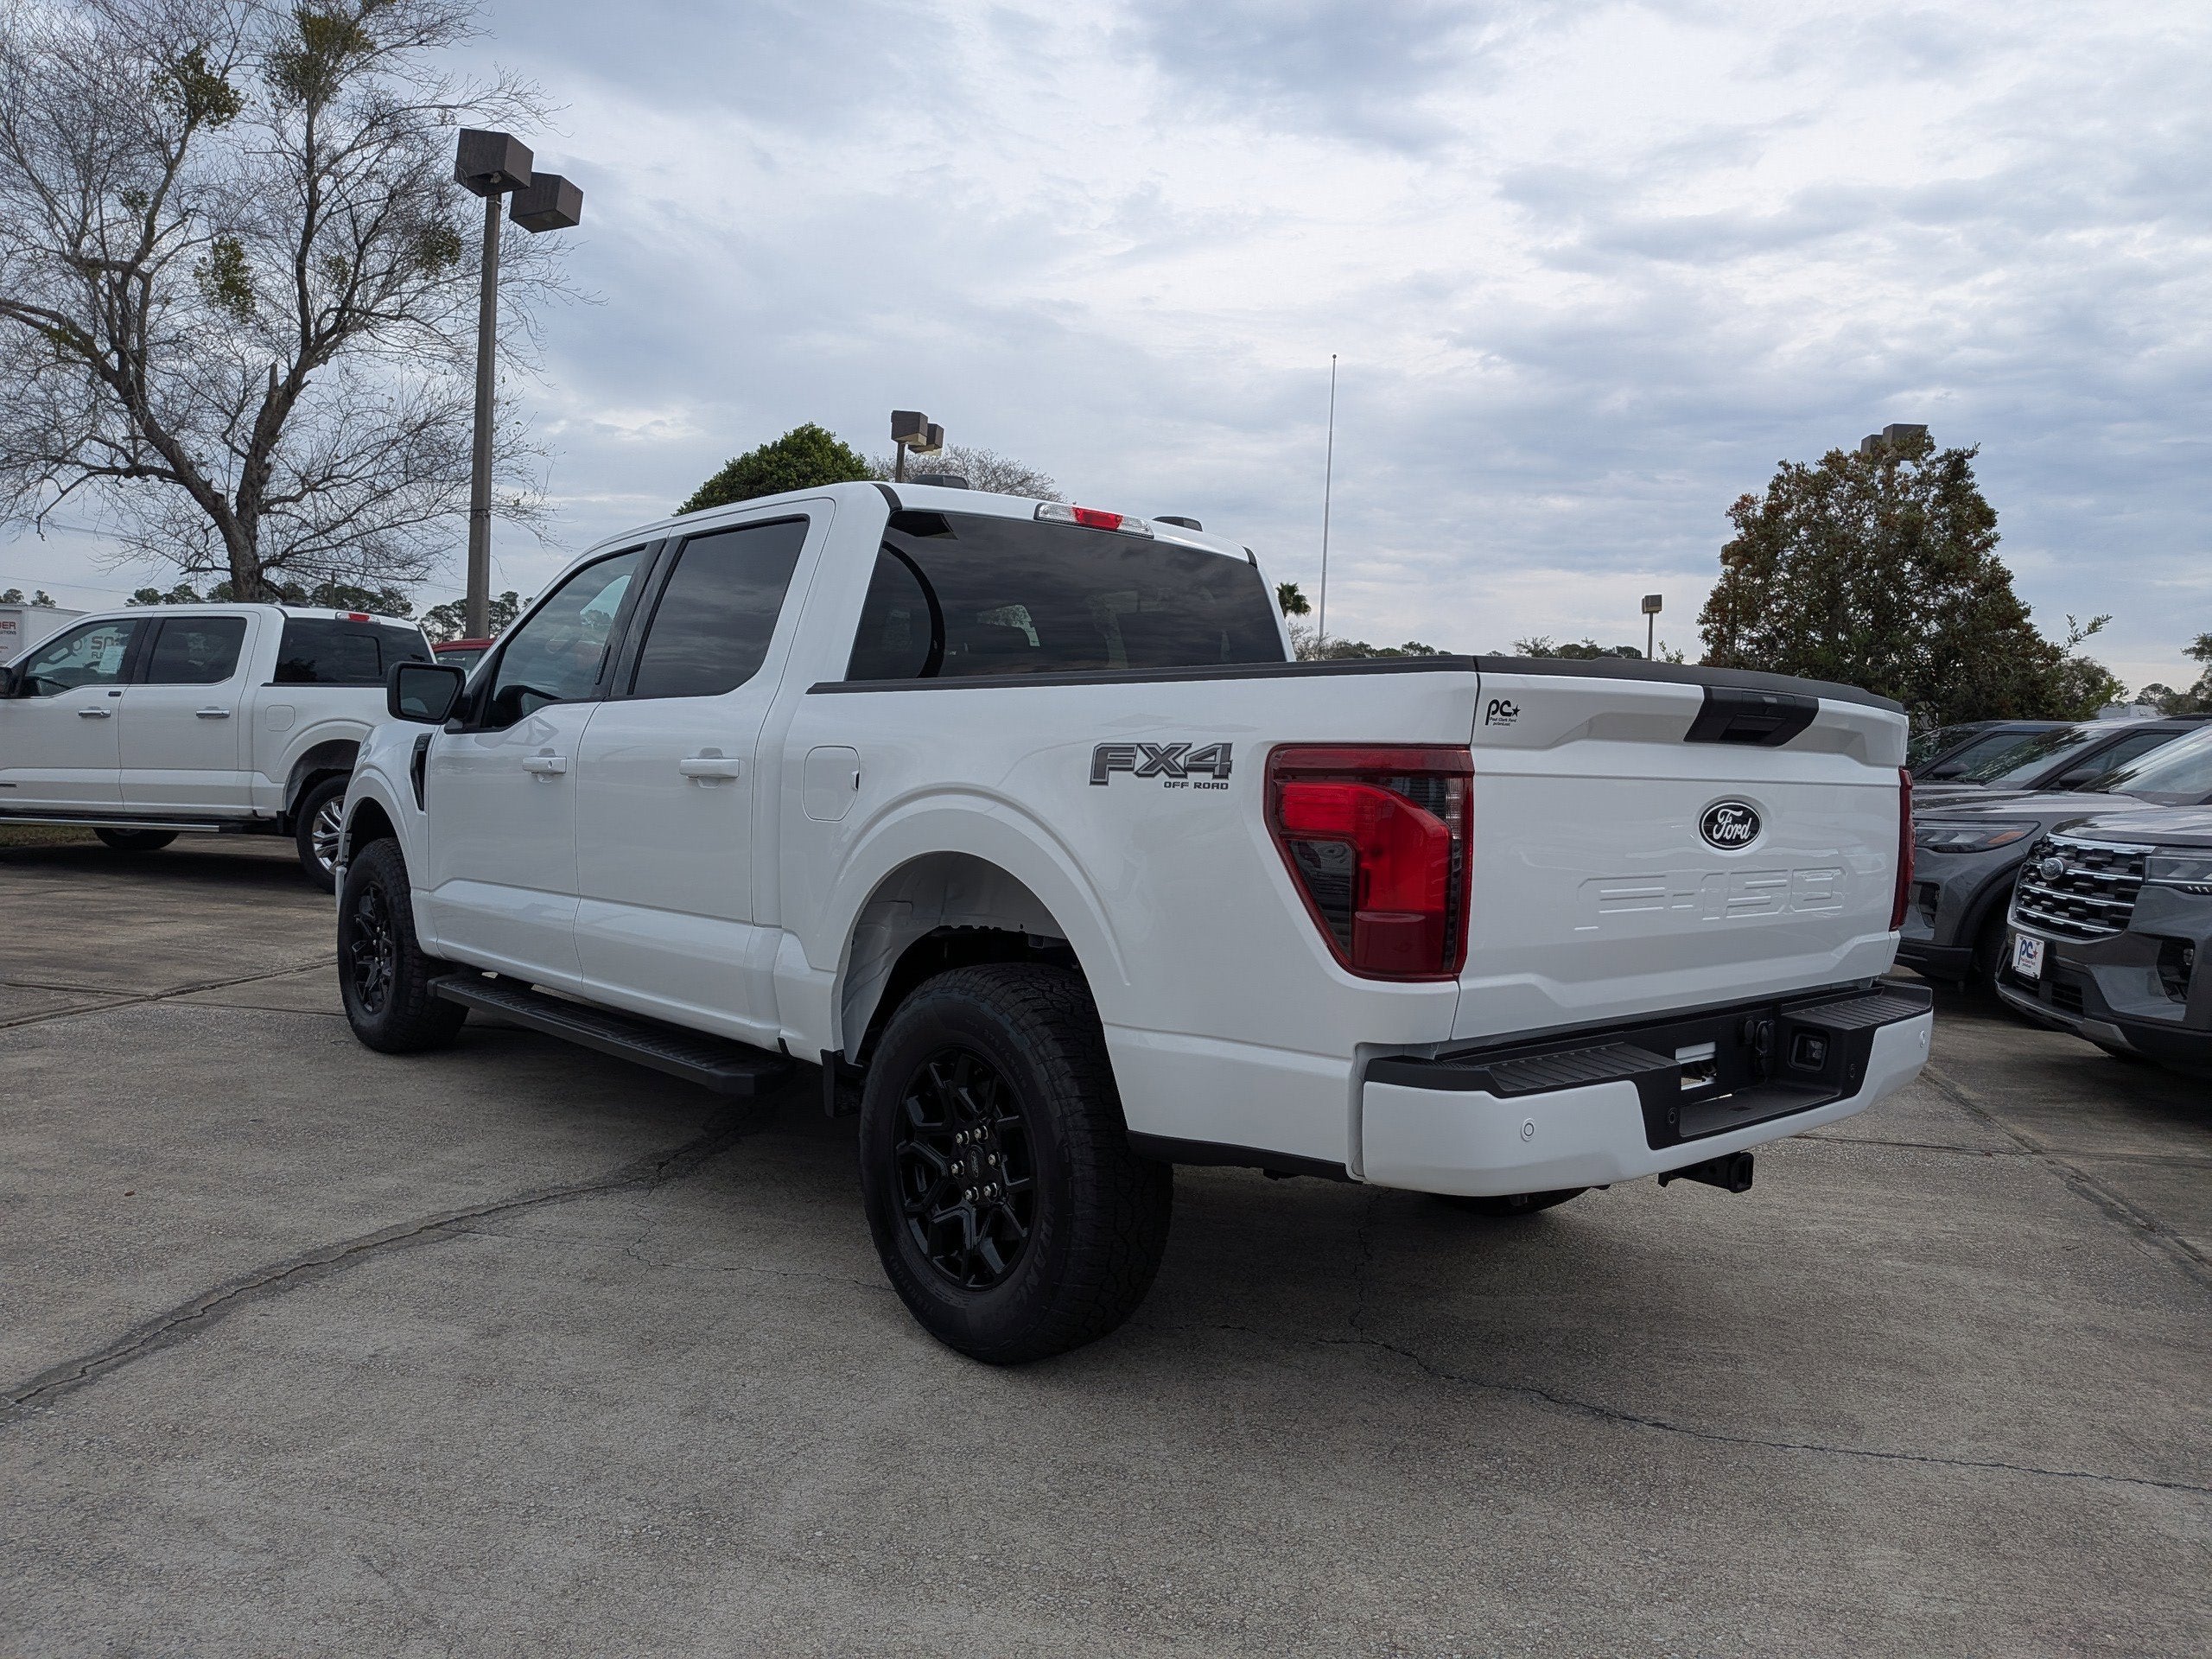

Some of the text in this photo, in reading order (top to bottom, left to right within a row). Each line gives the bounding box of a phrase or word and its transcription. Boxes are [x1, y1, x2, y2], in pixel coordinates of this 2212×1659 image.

[1090, 742, 1233, 785] FX4
[1193, 781, 1229, 791] ROAD
[1713, 808, 1752, 840] Ford
[1574, 866, 1847, 931] F-150
